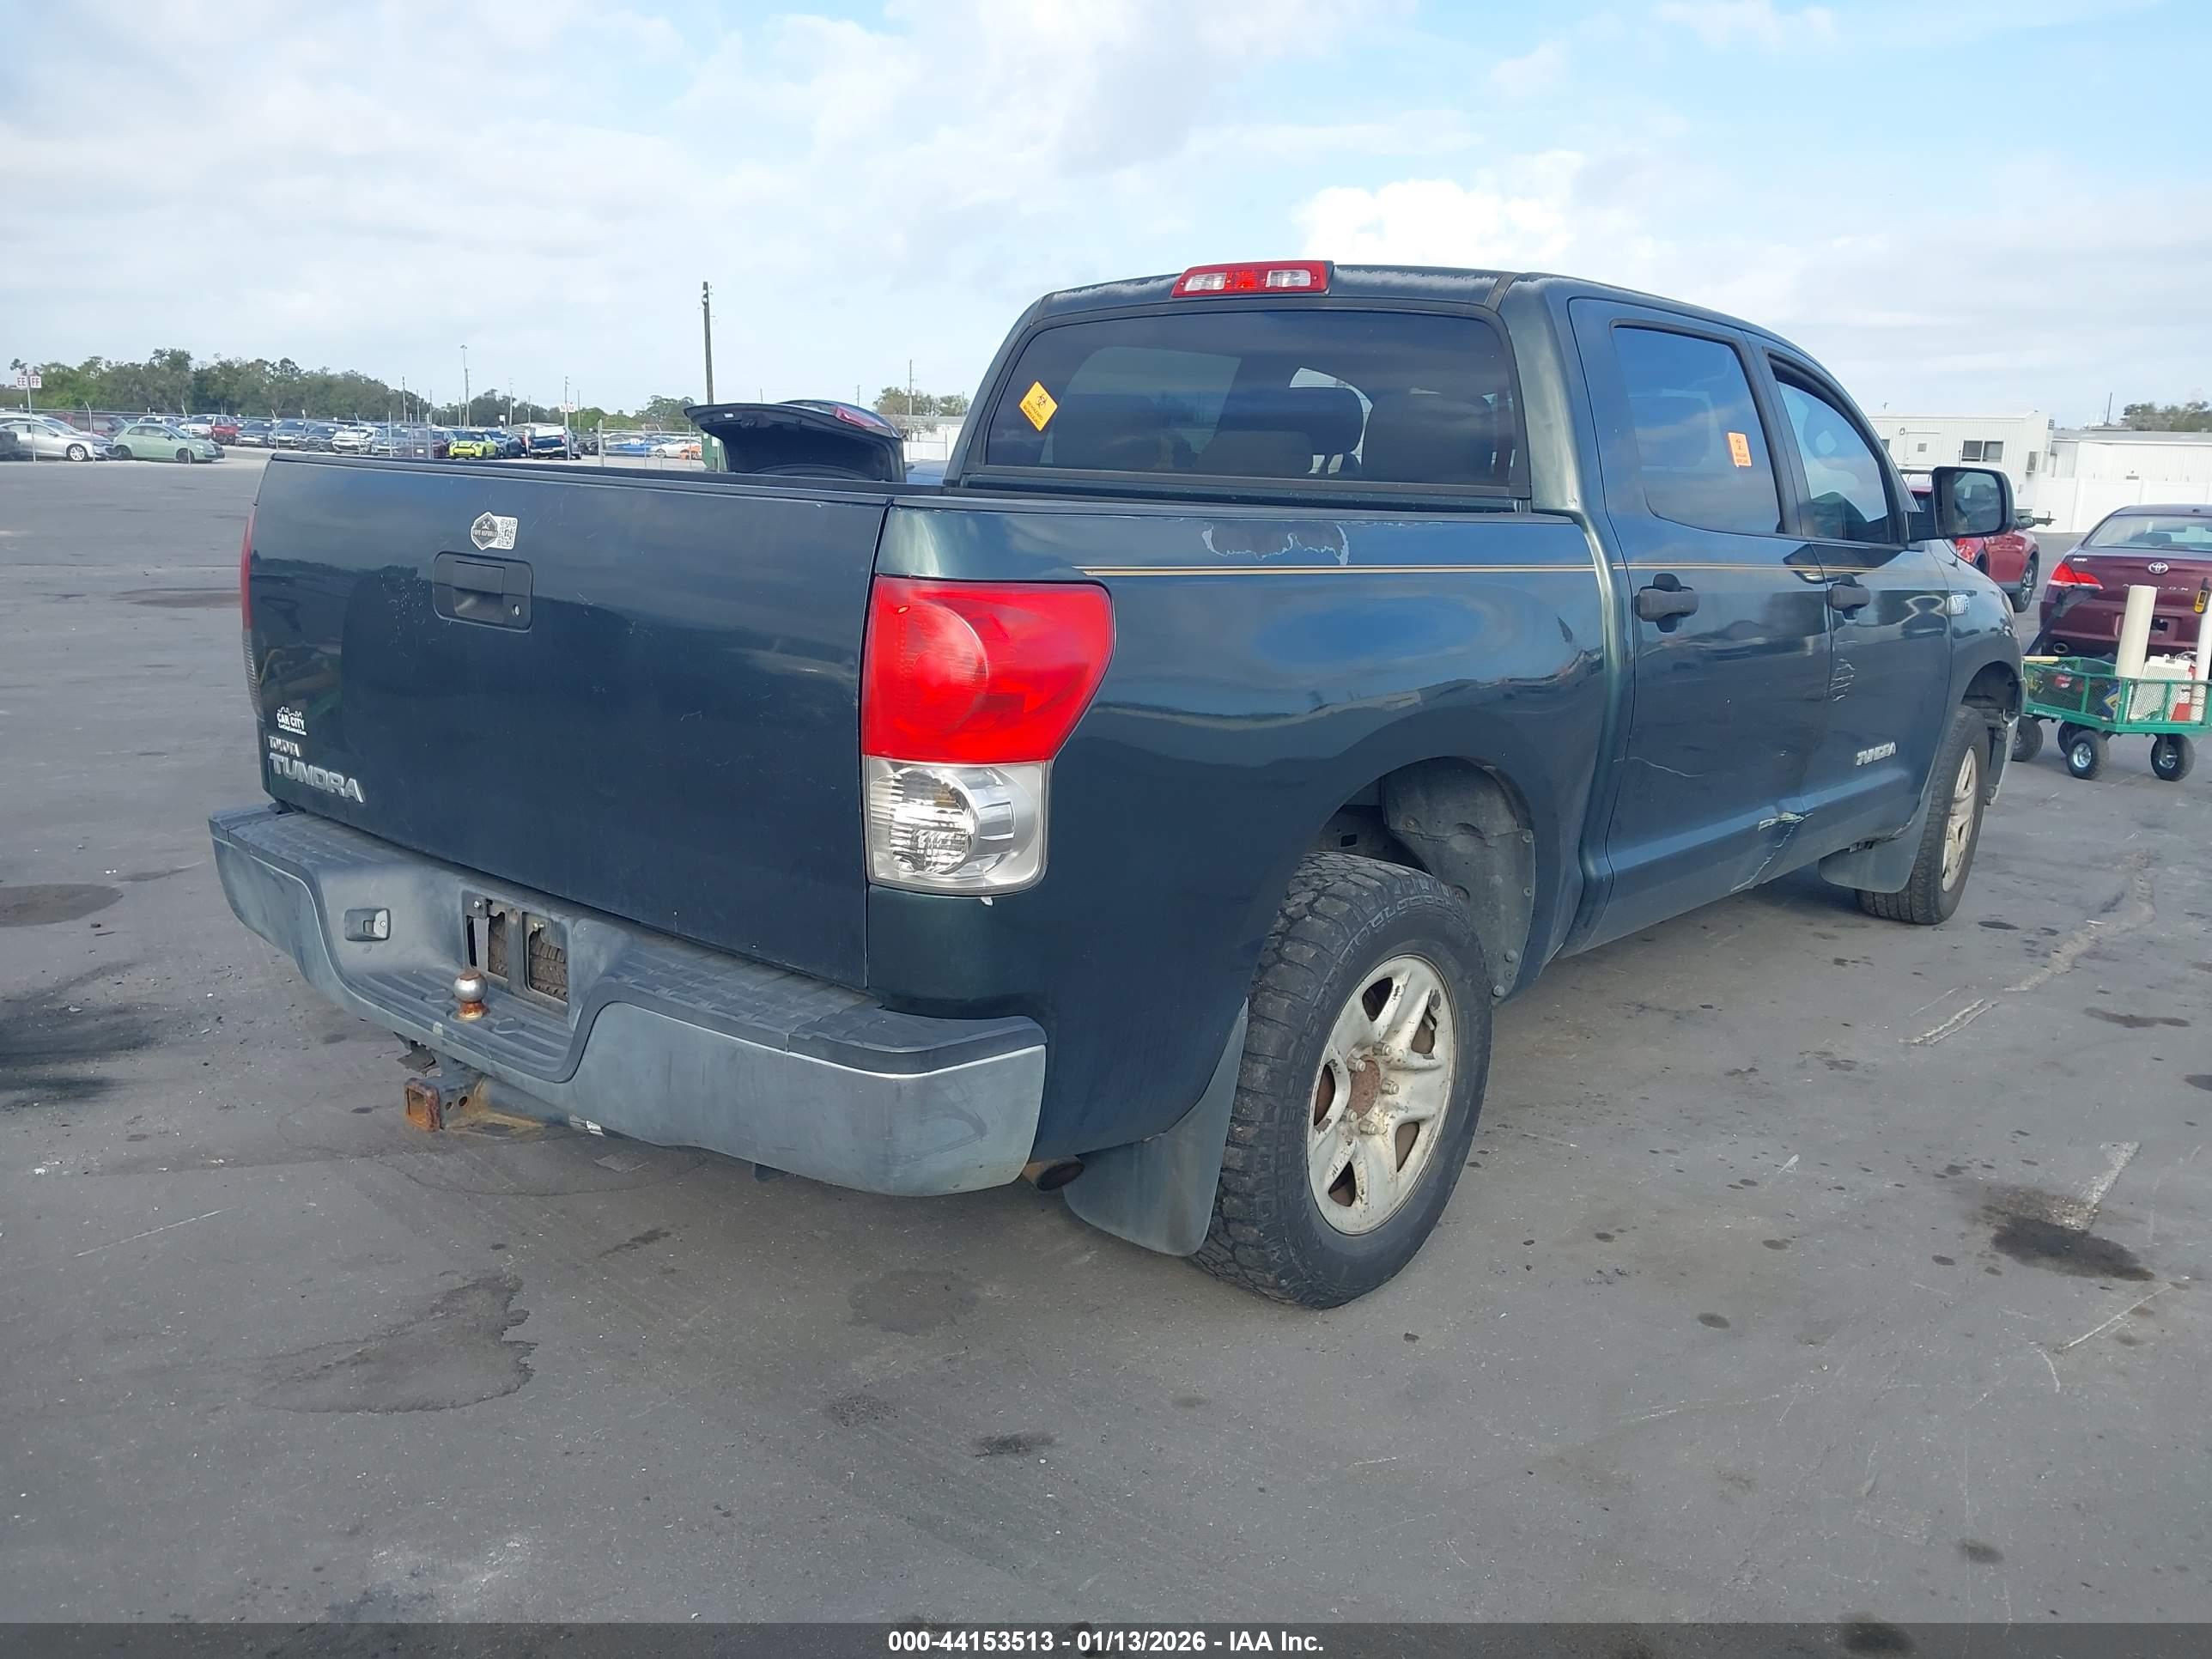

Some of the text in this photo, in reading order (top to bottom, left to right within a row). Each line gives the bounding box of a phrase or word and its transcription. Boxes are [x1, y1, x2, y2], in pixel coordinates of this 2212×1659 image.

[17, 377, 27, 386] EE
[31, 377, 40, 386] FF
[2122, 583, 2190, 592] ALON
[276, 712, 305, 730] CAR CITY
[268, 735, 301, 757] TOYOTA
[268, 752, 364, 804] TUNDRA
